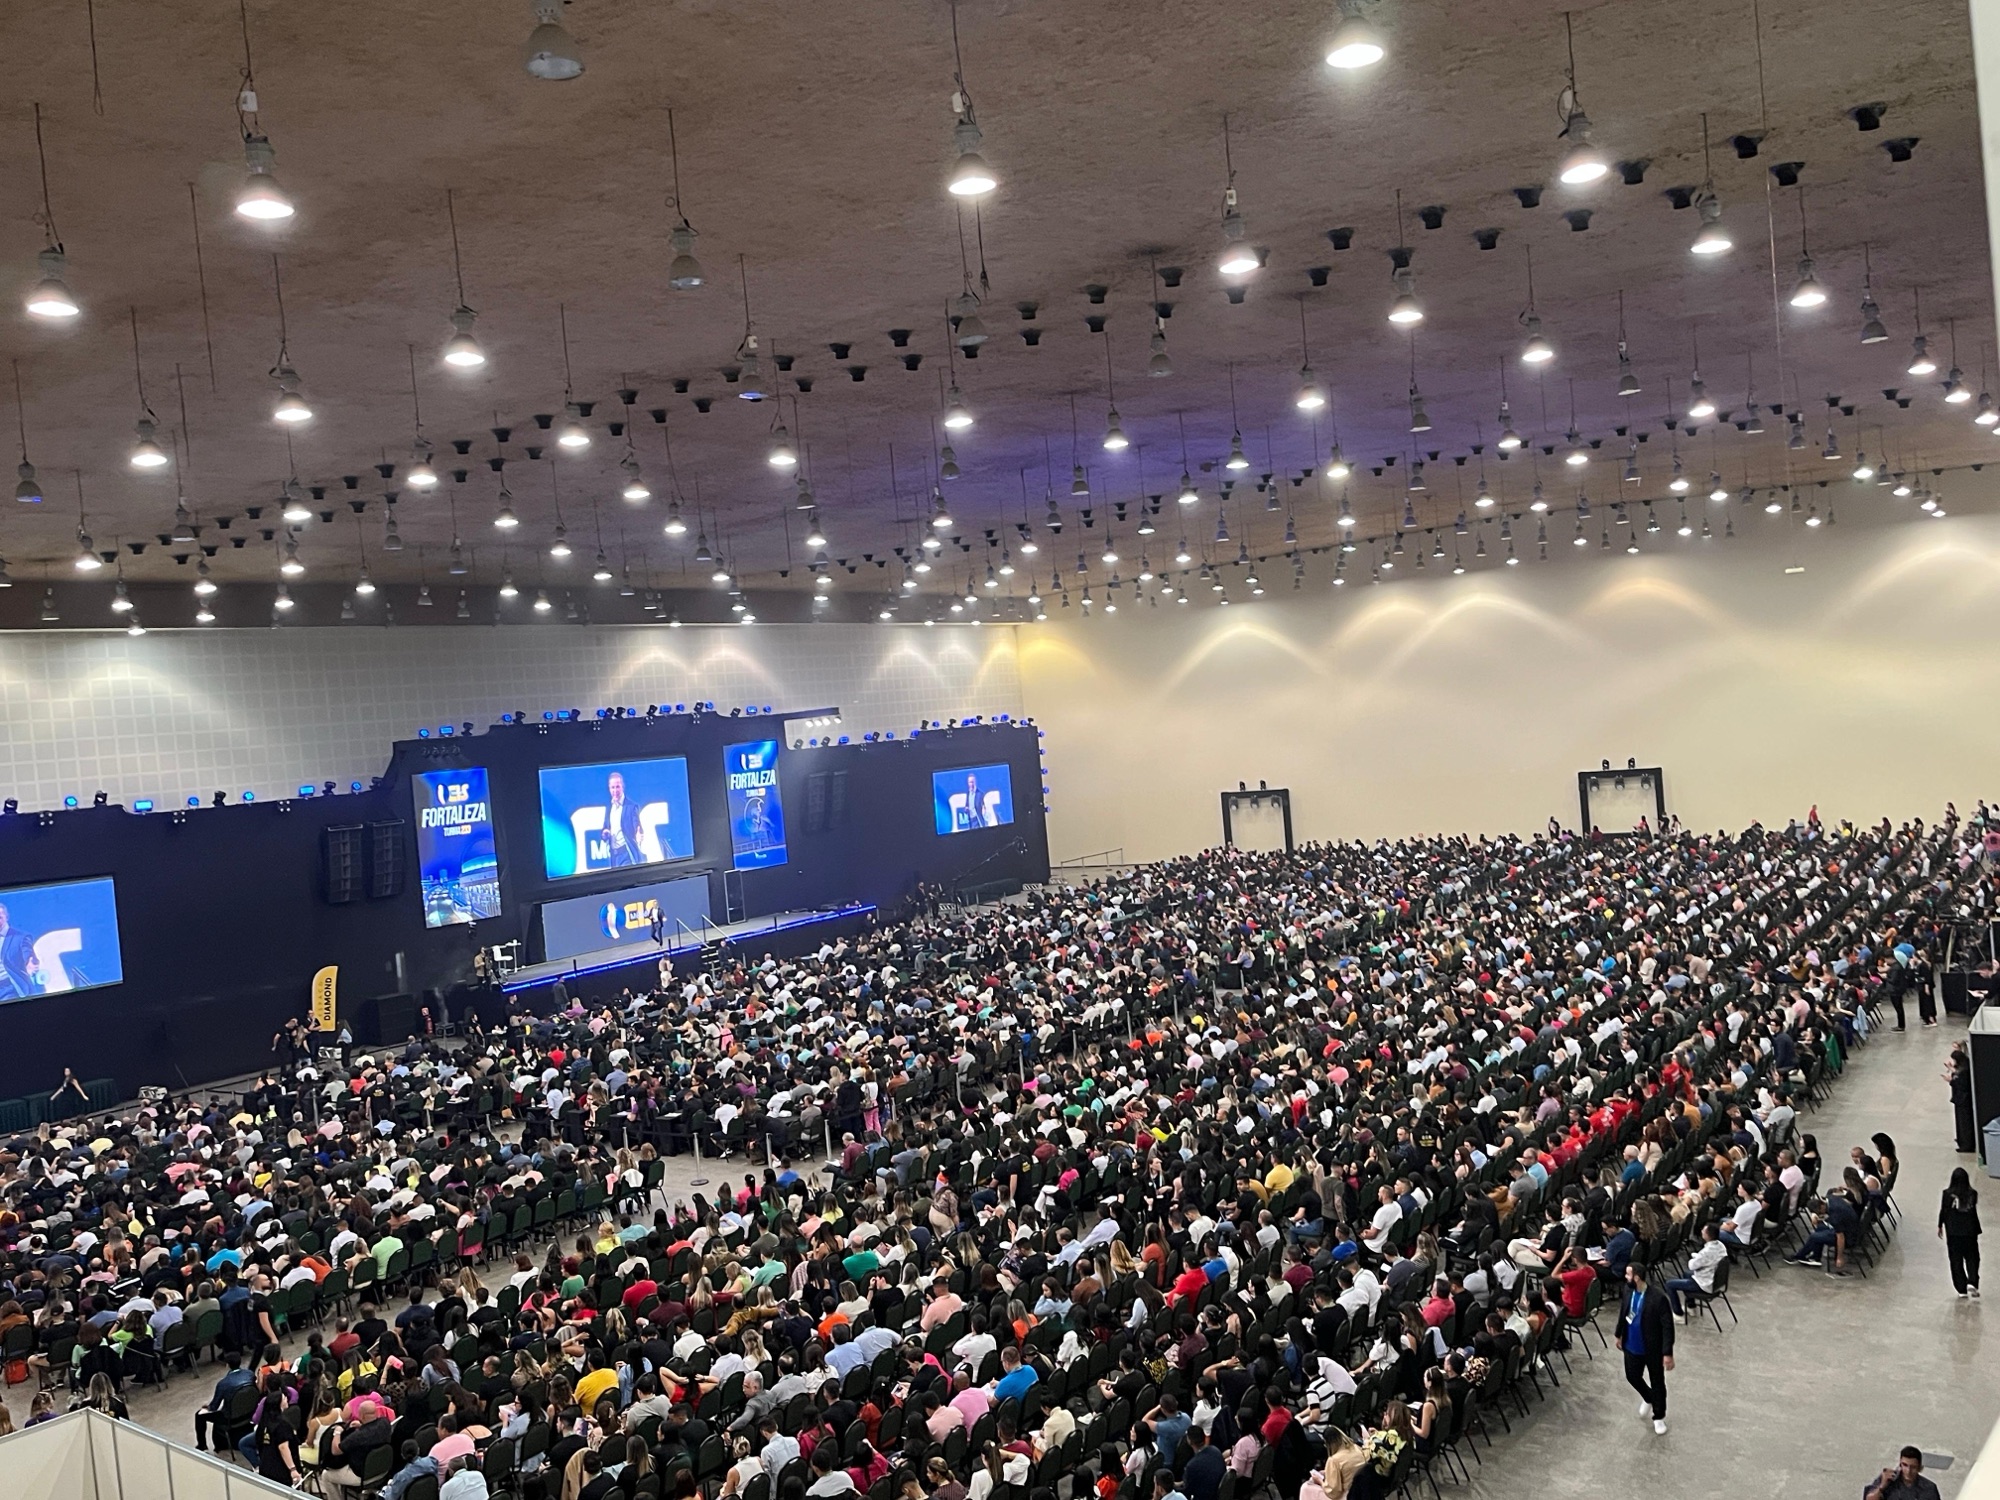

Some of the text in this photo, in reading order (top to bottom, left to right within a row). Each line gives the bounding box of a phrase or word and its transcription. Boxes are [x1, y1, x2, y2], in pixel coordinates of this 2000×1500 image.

[731, 769, 776, 790] FORTALEZA
[421, 802, 487, 828] FORTALEZA
[324, 977, 332, 1020] DIAMOND
